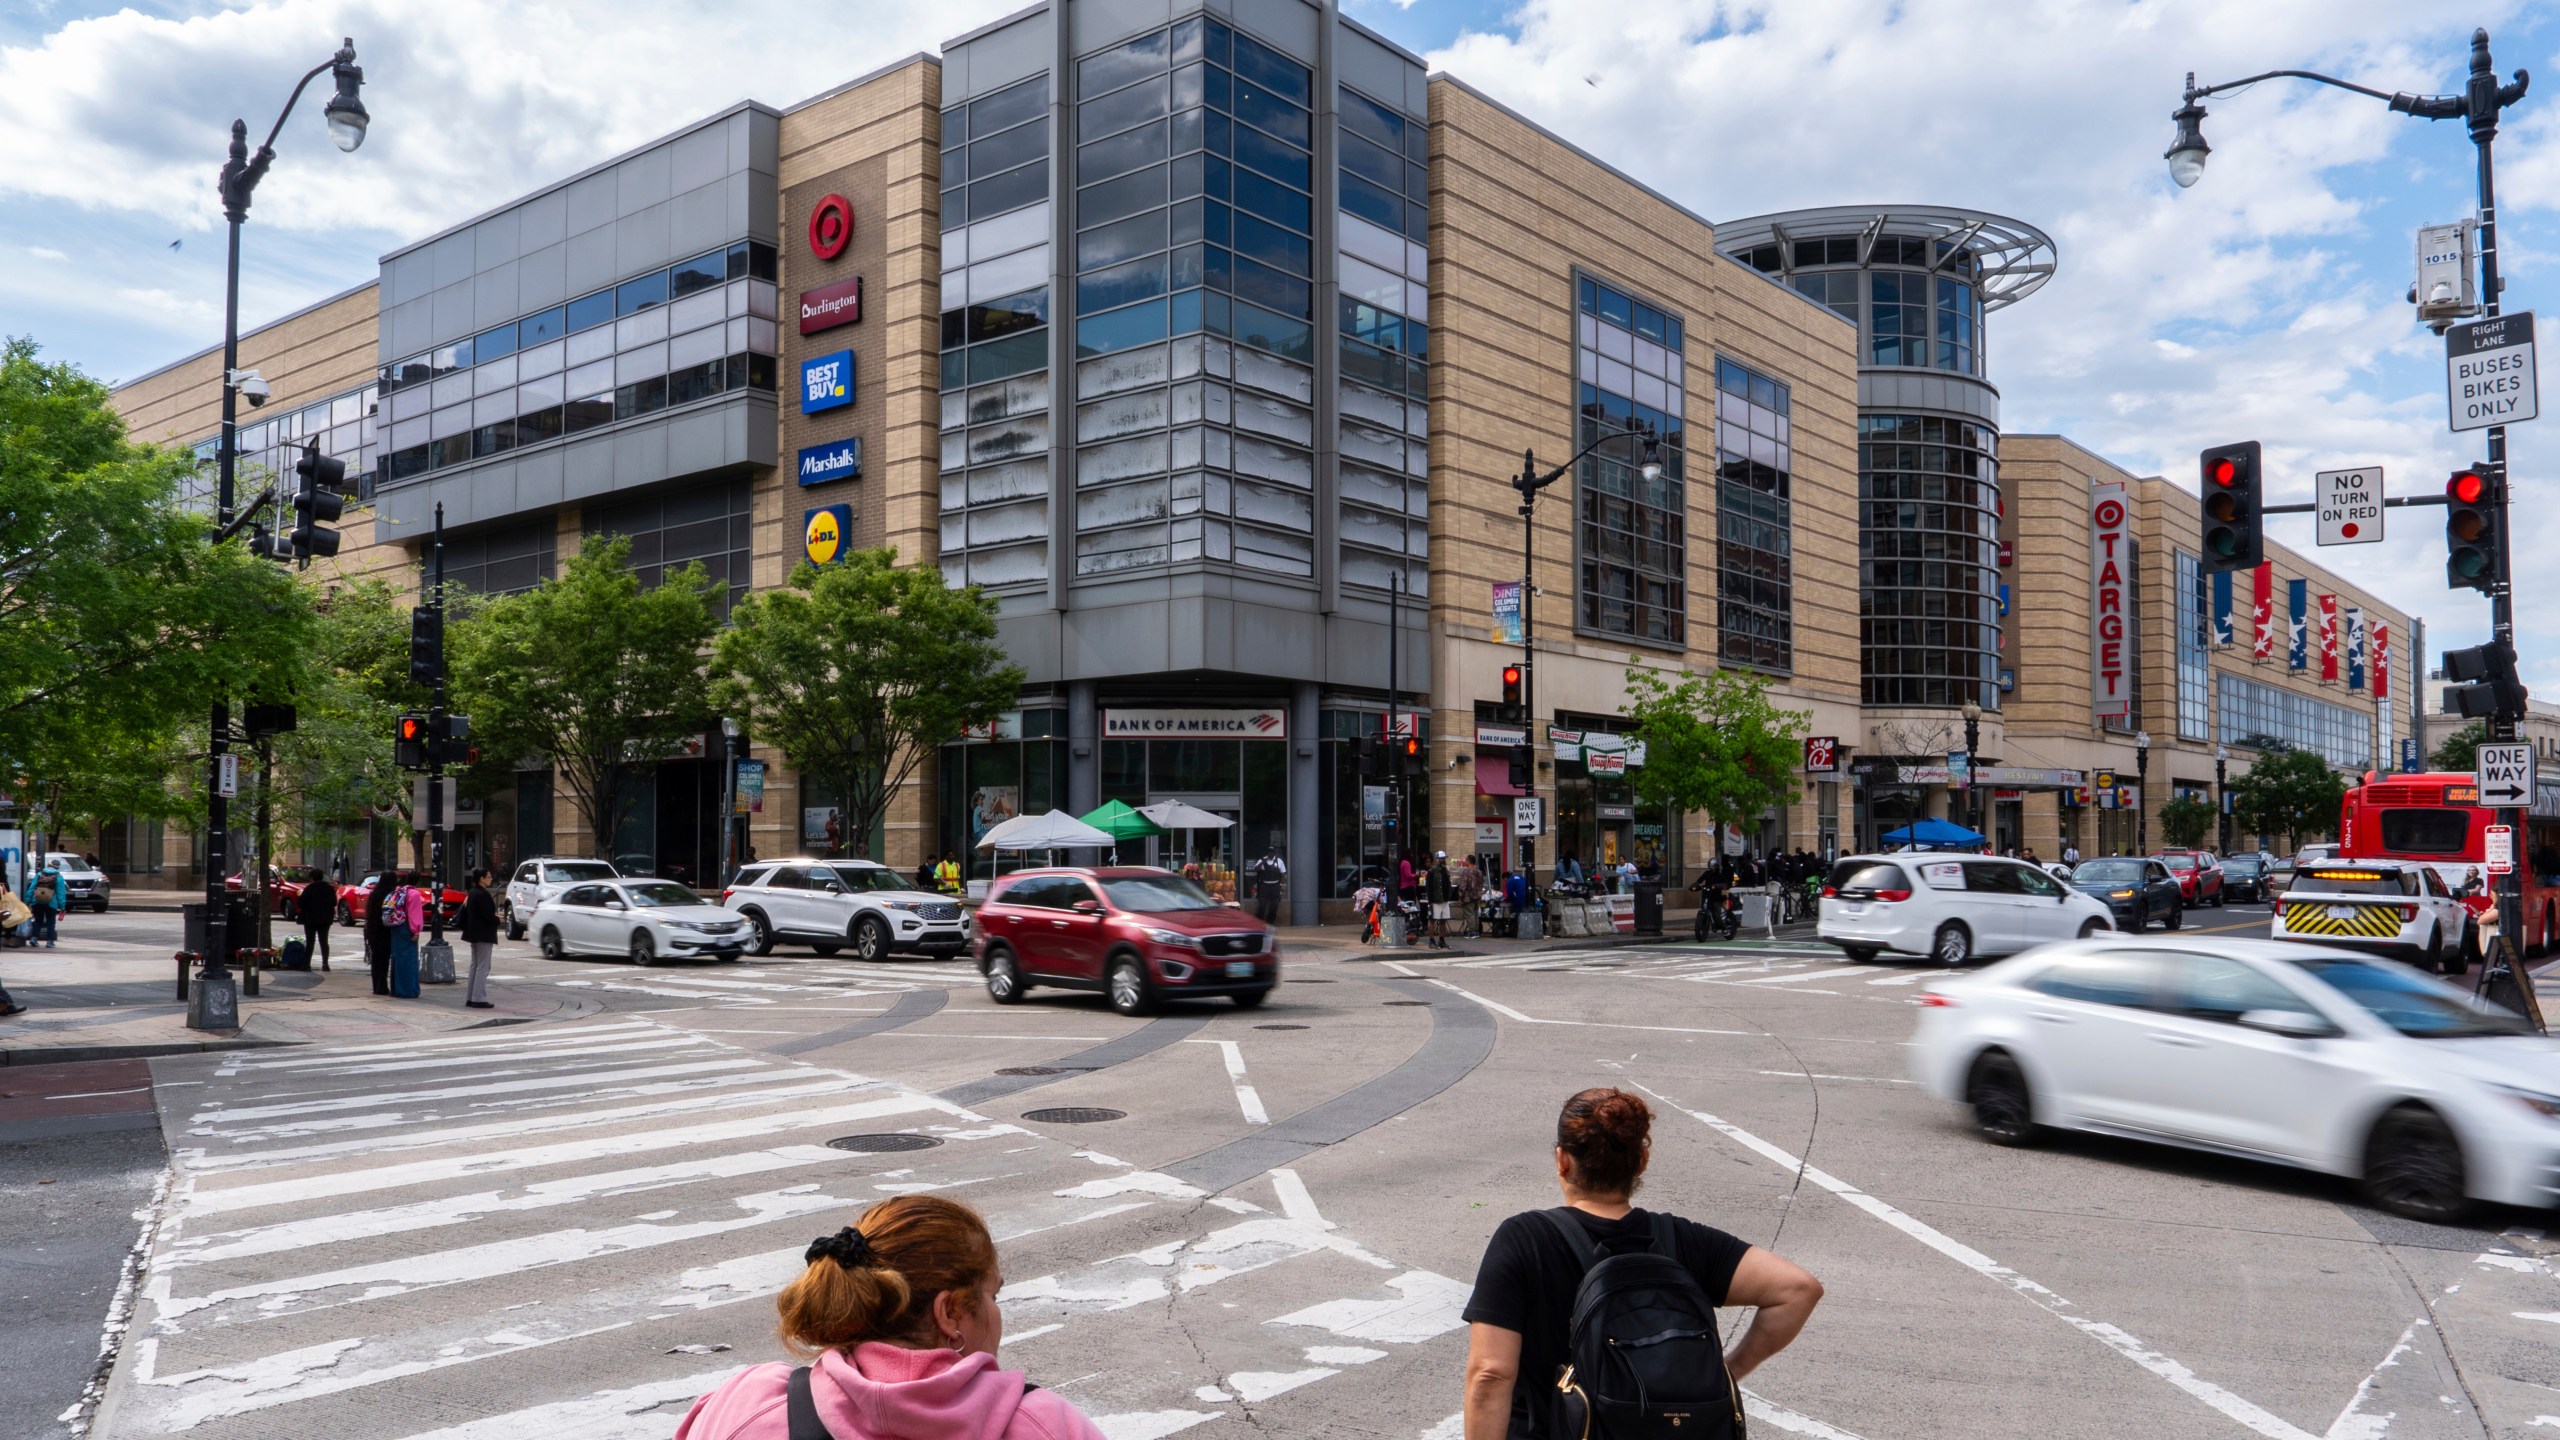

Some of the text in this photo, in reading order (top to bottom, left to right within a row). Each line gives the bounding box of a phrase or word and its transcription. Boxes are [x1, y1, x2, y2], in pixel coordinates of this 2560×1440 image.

[2425, 253, 2457, 265] 1015
[801, 295, 857, 319] Burlington
[2472, 321, 2507, 336] RIGHT
[2474, 335, 2506, 350] LANE
[806, 361, 840, 386] BEST
[2459, 354, 2524, 379] BUSES
[809, 379, 837, 401] BUY
[2463, 375, 2521, 399] BIKES
[2467, 396, 2519, 419] ONLY
[801, 448, 854, 476] Marshalls
[2335, 474, 2364, 490] NO
[2331, 491, 2370, 506] TURN
[2322, 505, 2378, 522] ON RED
[1493, 588, 1520, 600] DINE
[2099, 532, 2122, 696] TARGET
[1109, 720, 1246, 731] BANK OF AMERICA
[1480, 734, 1493, 742] BANK
[1502, 736, 1521, 744] AMERICA
[2406, 740, 2416, 760] PARK
[2485, 749, 2525, 764] ONE
[738, 763, 763, 772] SHOP
[1589, 754, 1624, 770] Krispy Kreme
[2004, 772, 2044, 781] BEST BUY
[2485, 766, 2527, 781] WAY
[1518, 801, 1536, 810] ONE
[1604, 808, 1626, 816] WELCOME
[1518, 812, 1537, 820] WAY
[1634, 824, 1663, 836] BREAKFAST
